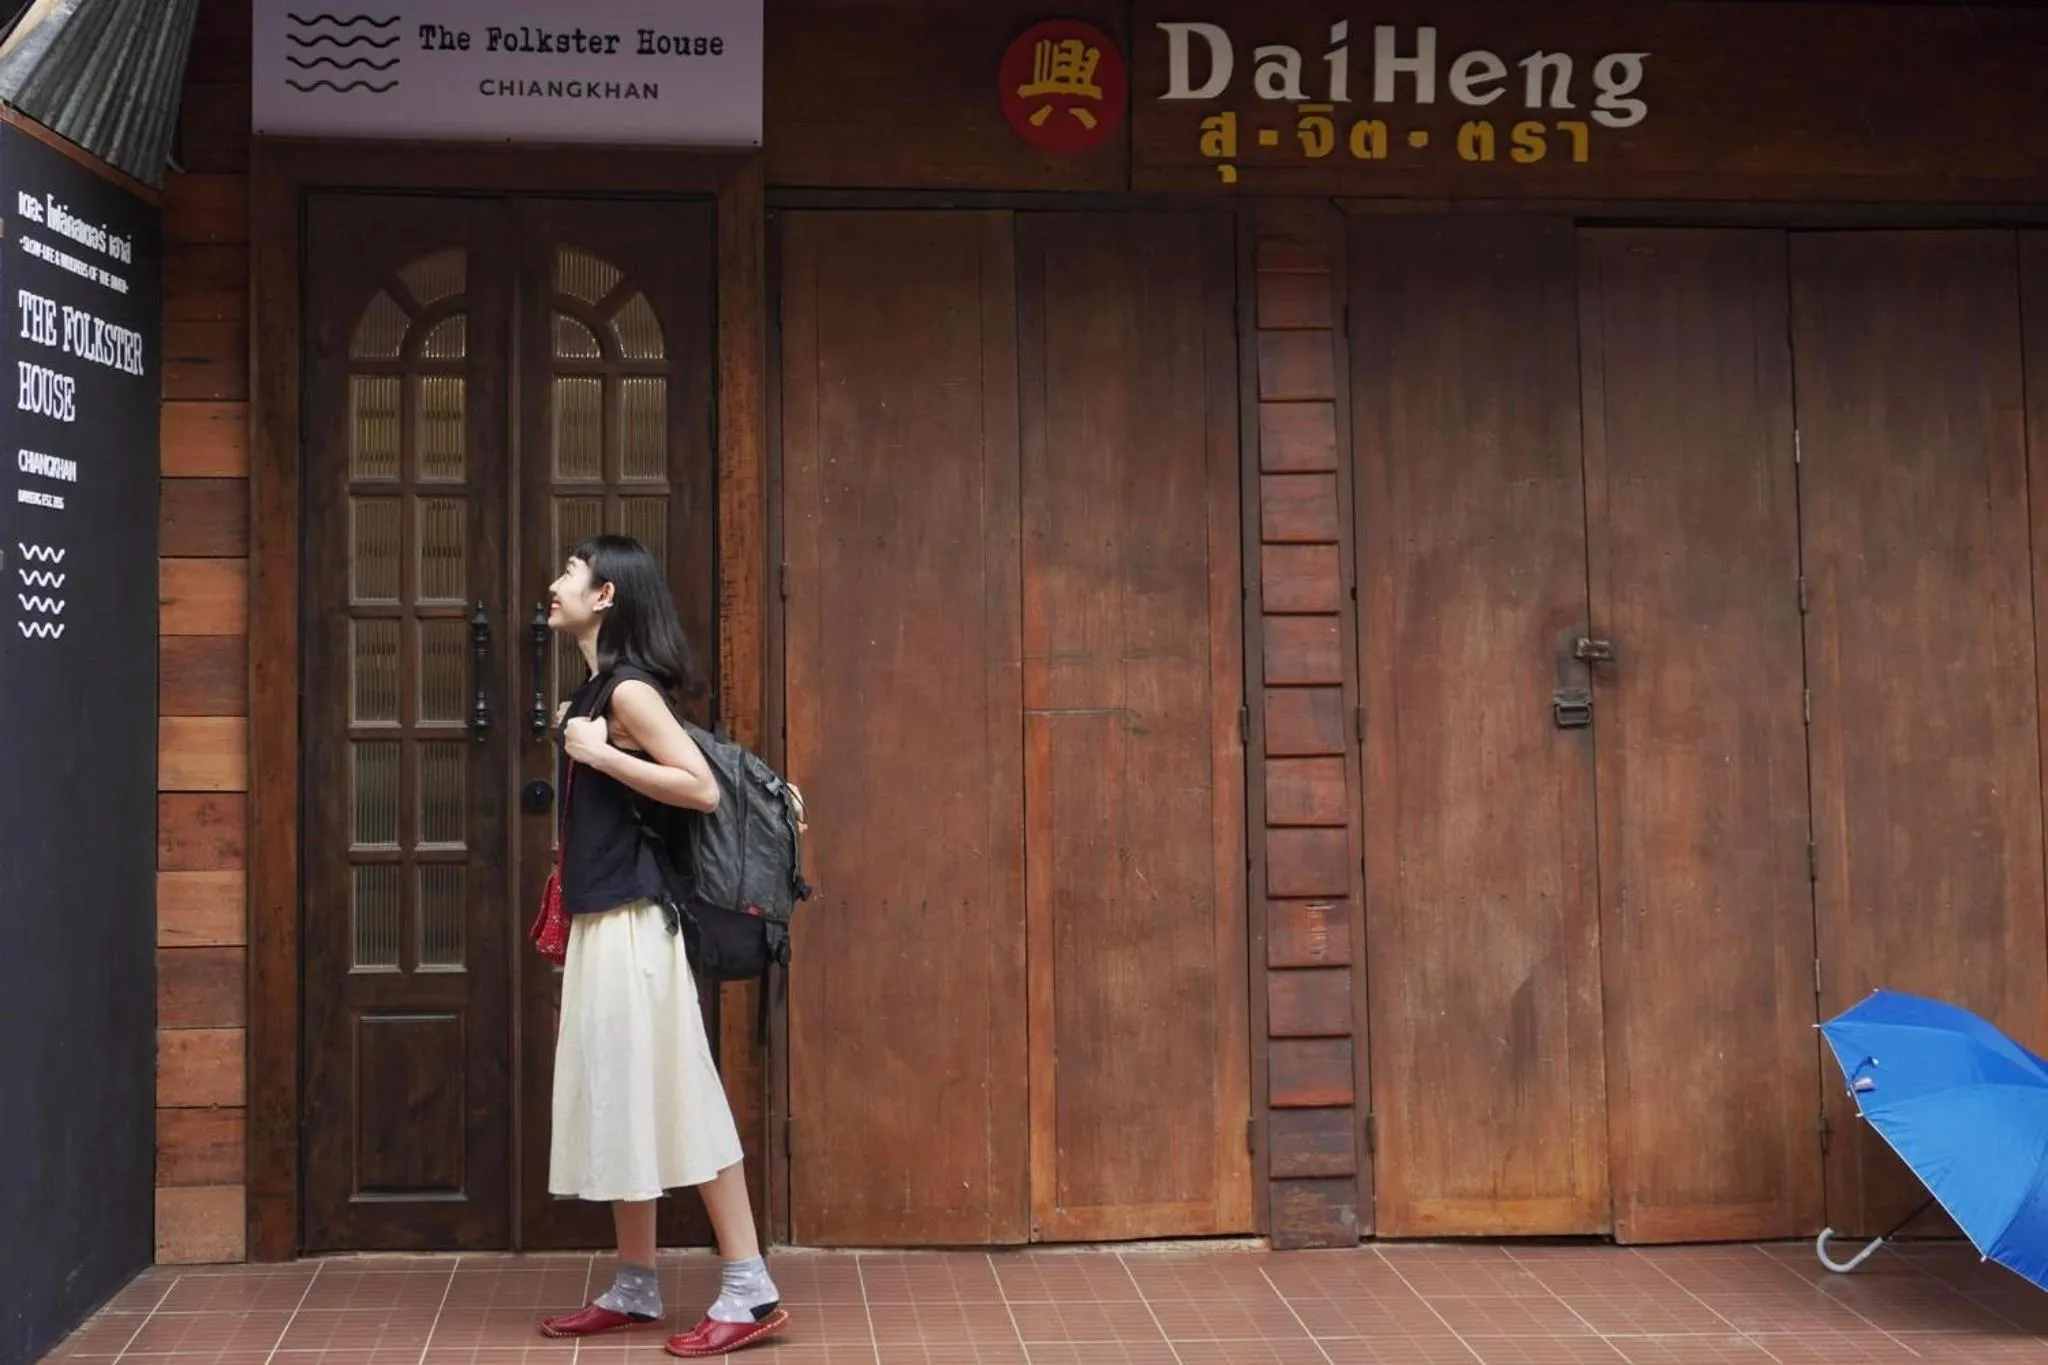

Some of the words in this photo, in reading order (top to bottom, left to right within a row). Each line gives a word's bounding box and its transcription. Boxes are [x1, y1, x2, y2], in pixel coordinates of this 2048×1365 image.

[418, 24, 471, 51] The
[486, 26, 621, 55] Folkster
[636, 28, 724, 56] House
[479, 78, 659, 100] CHIANGKHAN
[1156, 20, 1651, 128] DaiHeng
[18, 289, 57, 346] THE
[61, 305, 144, 376] FOLKSTER
[17, 360, 76, 422] HOUSE
